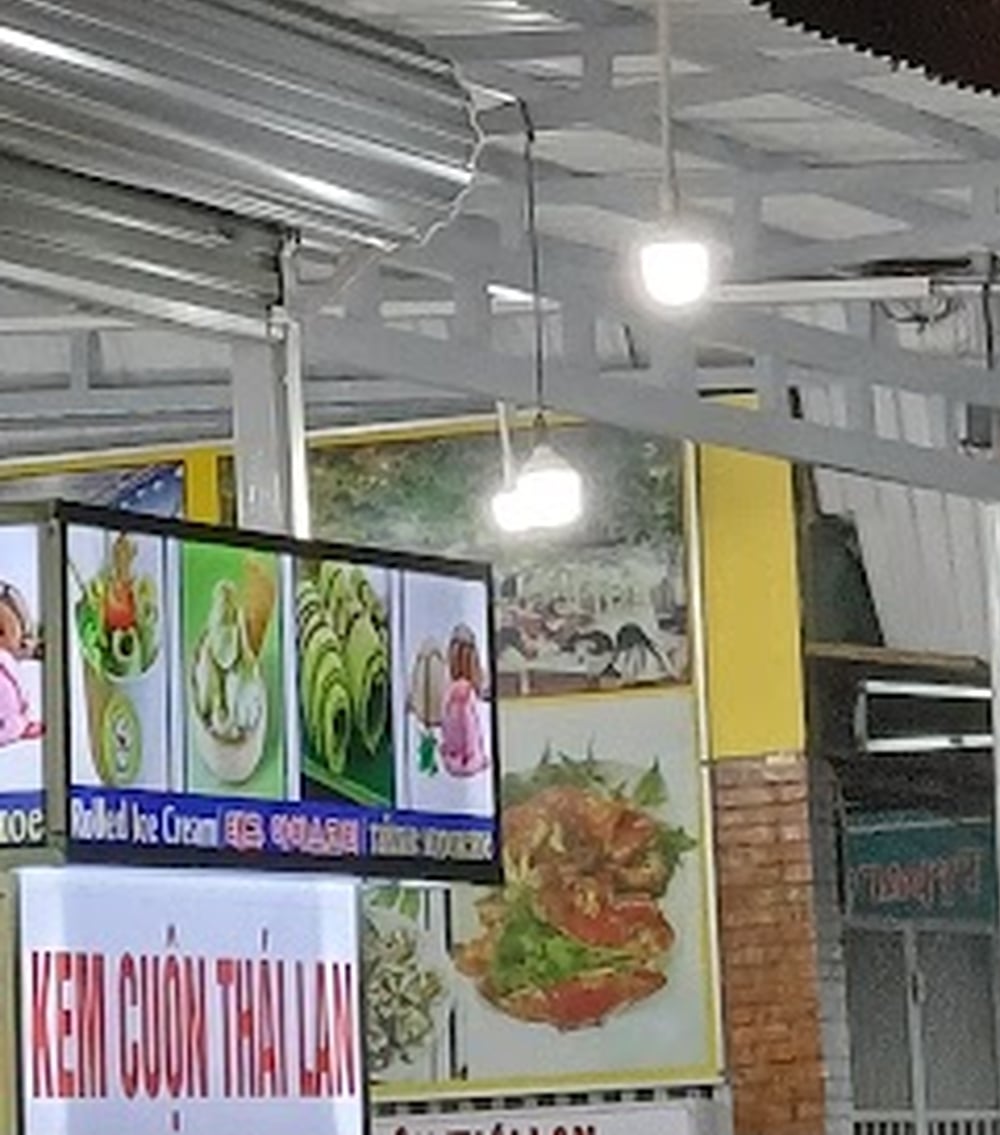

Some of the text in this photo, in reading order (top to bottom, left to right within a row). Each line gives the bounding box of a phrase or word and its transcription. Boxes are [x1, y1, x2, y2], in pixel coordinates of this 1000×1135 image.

[162, 804, 218, 848] Cream
[32, 951, 107, 1098] KEM
[216, 927, 288, 1098] THÁI
[297, 960, 356, 1098] LAN
